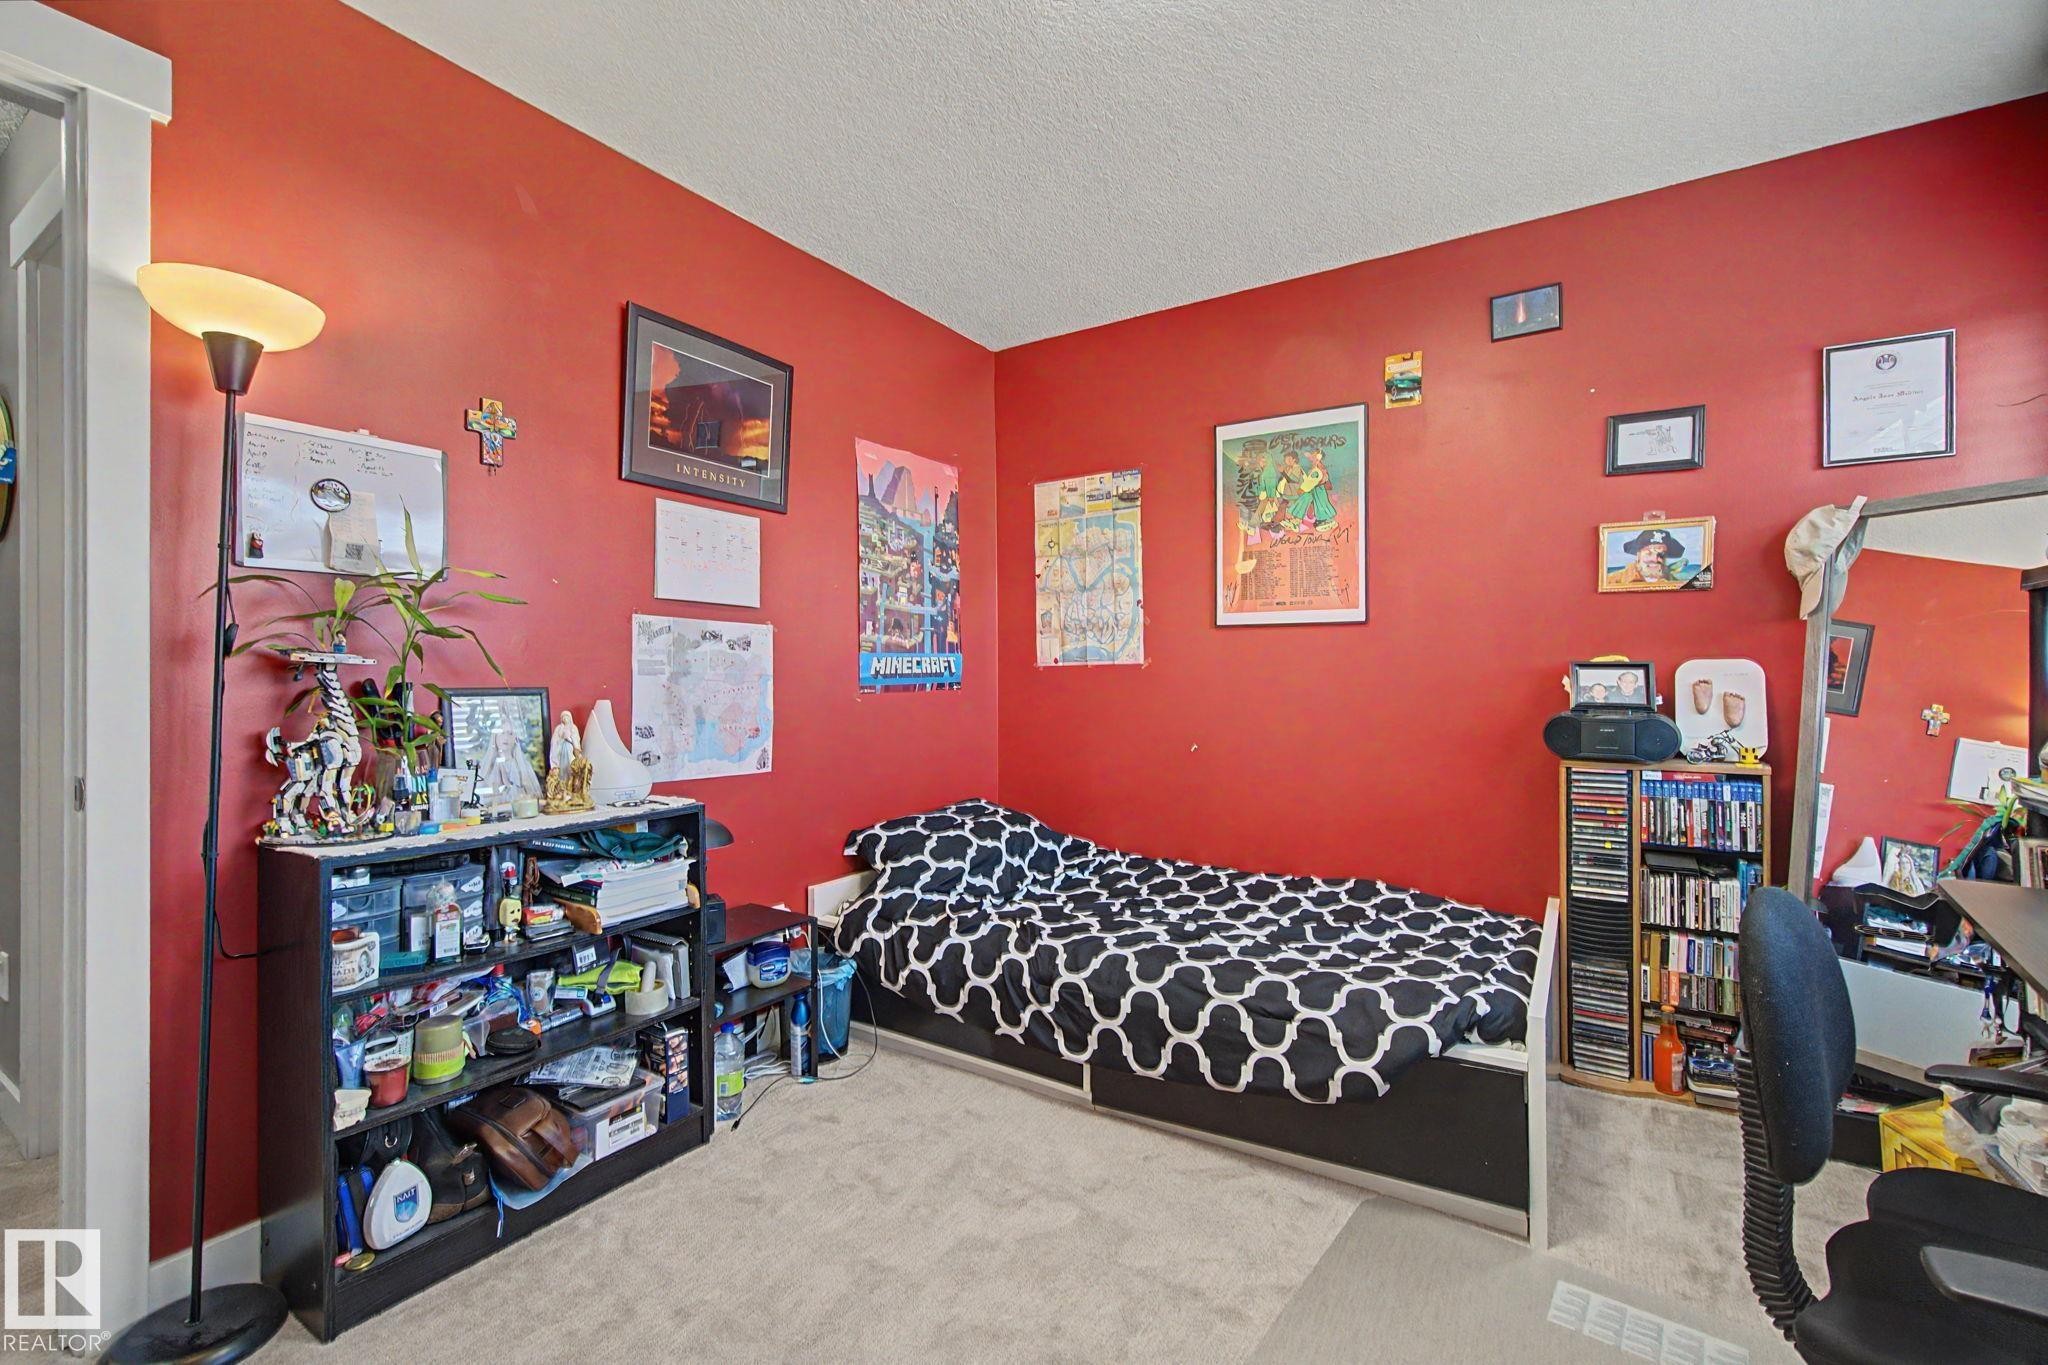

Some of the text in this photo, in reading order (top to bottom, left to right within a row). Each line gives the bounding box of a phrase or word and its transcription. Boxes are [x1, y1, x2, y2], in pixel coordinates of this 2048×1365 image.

[1281, 434, 1347, 453] DINOSAURS
[675, 463, 747, 488] INTENSITY
[870, 656, 957, 679] MINECRAFT
[396, 1187, 417, 1203] NAIT
